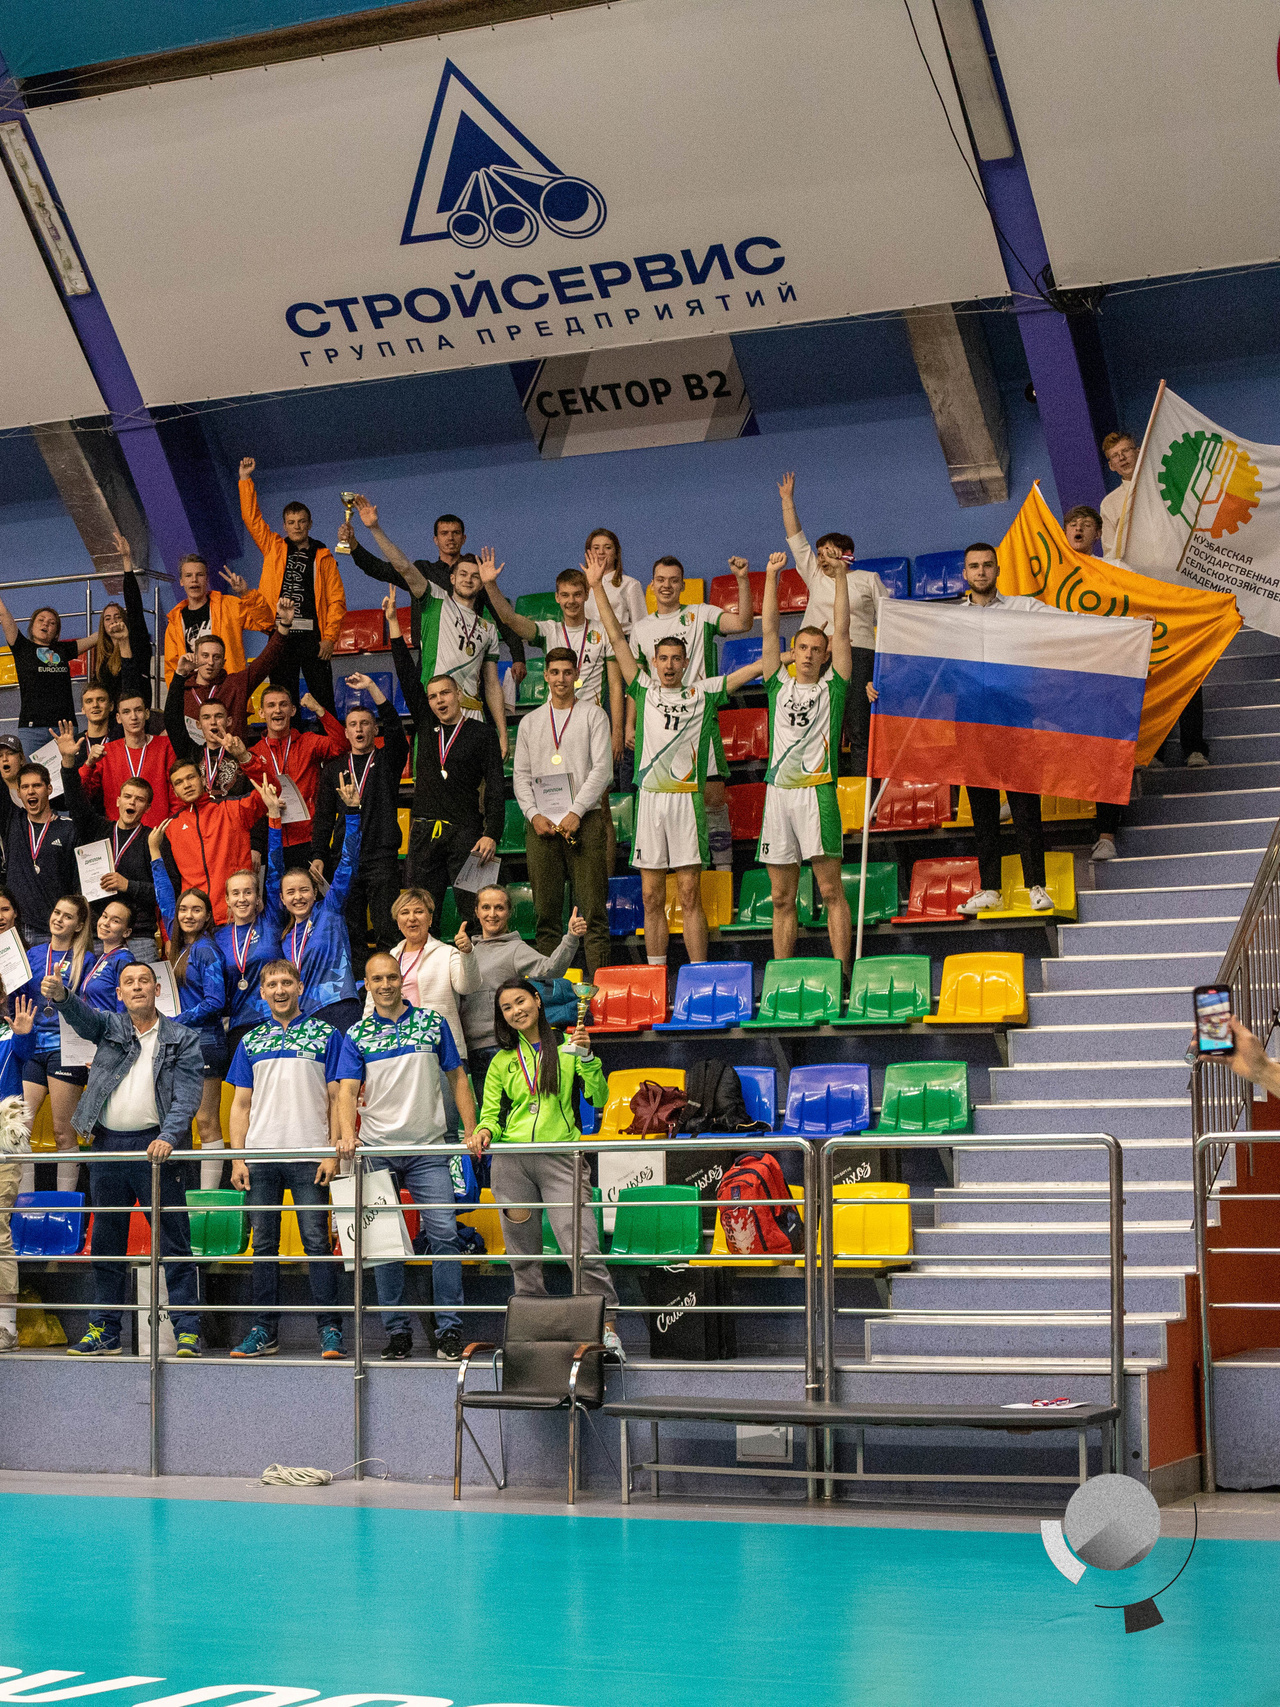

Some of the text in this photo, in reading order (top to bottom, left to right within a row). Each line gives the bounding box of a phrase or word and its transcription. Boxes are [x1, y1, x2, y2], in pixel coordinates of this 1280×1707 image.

[284, 236, 786, 338] СТРОЙСЕРВИС
[300, 282, 798, 368] ГРУППА ПРЕДПРИЯТИЙ
[537, 375, 673, 418] СЕКТОР
[1188, 544, 1280, 588] ГОСУДАРСТВЕННАЯ
[1193, 533, 1254, 566] КУЗБАССКАЯ
[664, 713, 680, 731] 11
[788, 712, 810, 728] 13
